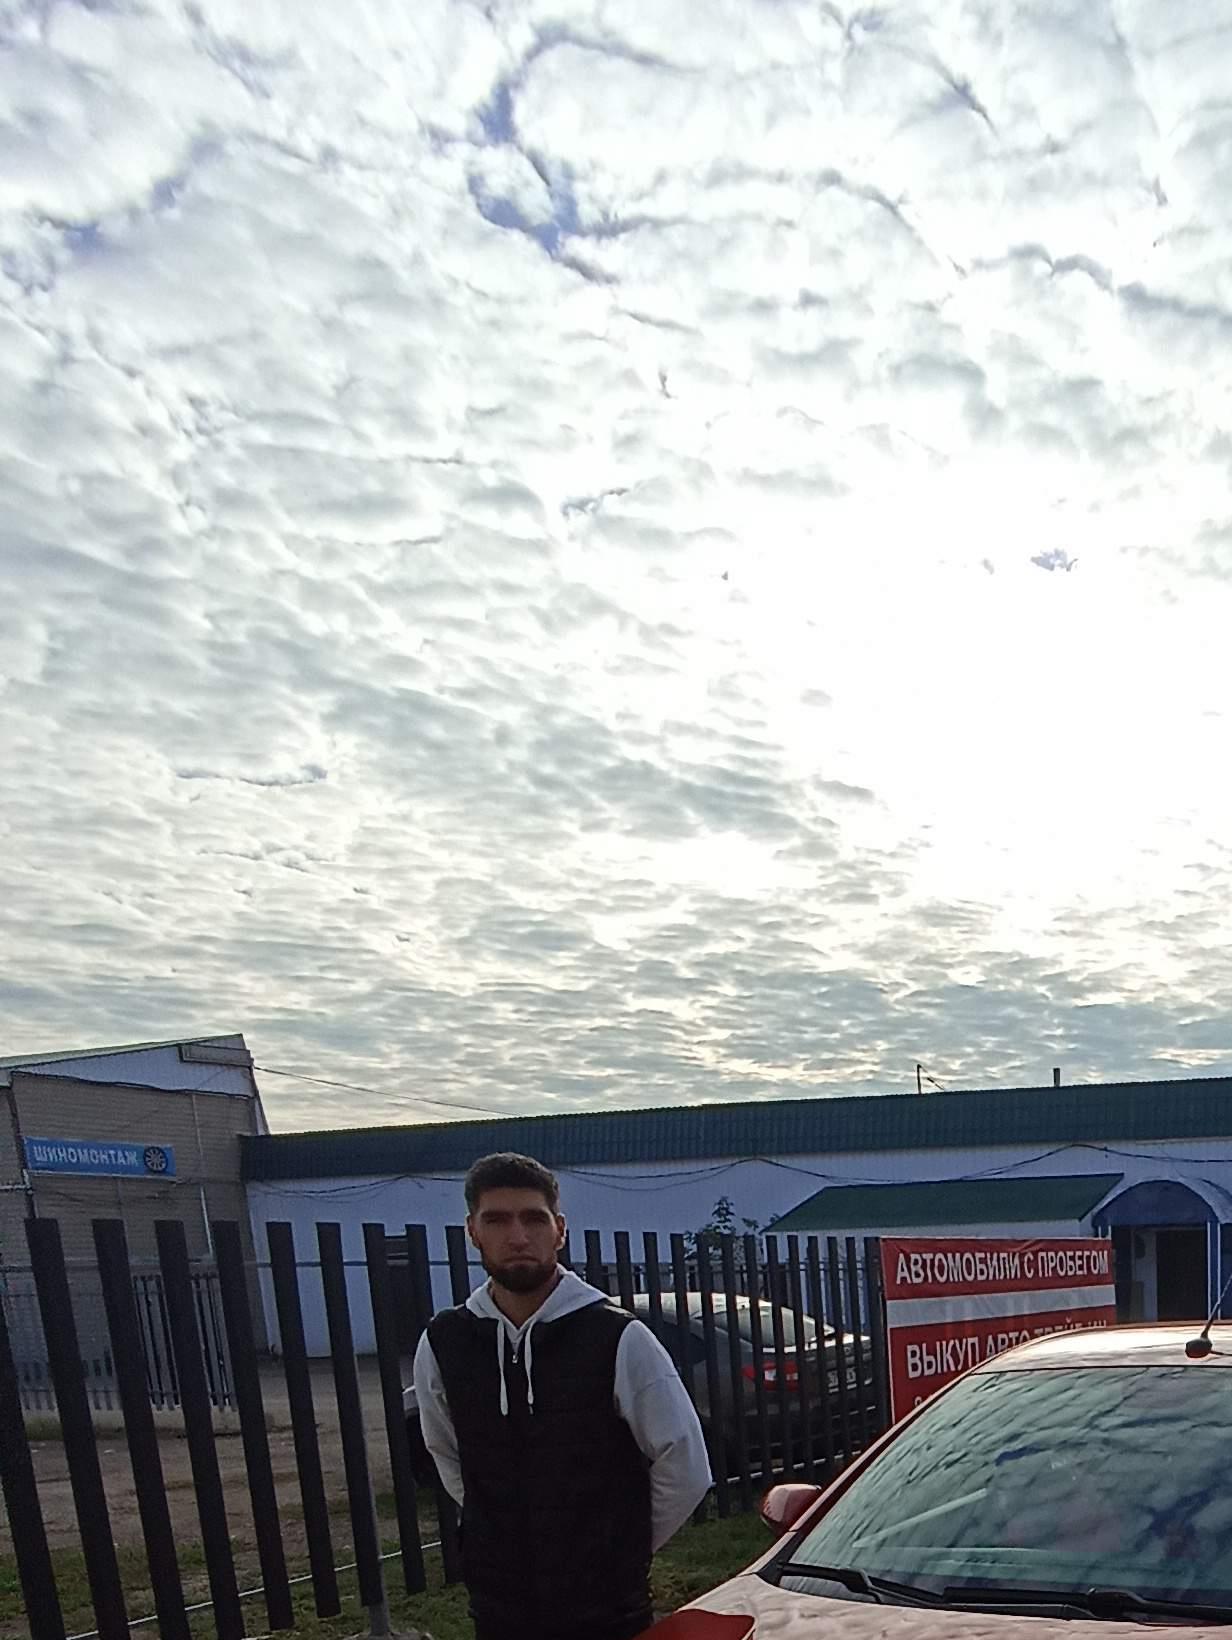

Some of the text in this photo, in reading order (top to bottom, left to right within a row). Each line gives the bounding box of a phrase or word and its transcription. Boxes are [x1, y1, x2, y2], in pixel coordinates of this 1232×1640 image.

[33, 1145, 139, 1167] ШИНОМОНТАЖ
[896, 1249, 1109, 1285] АВТОМОБИЛИ С ПРОБЕГОМ
[906, 1336, 980, 1379] ВЫКУП
